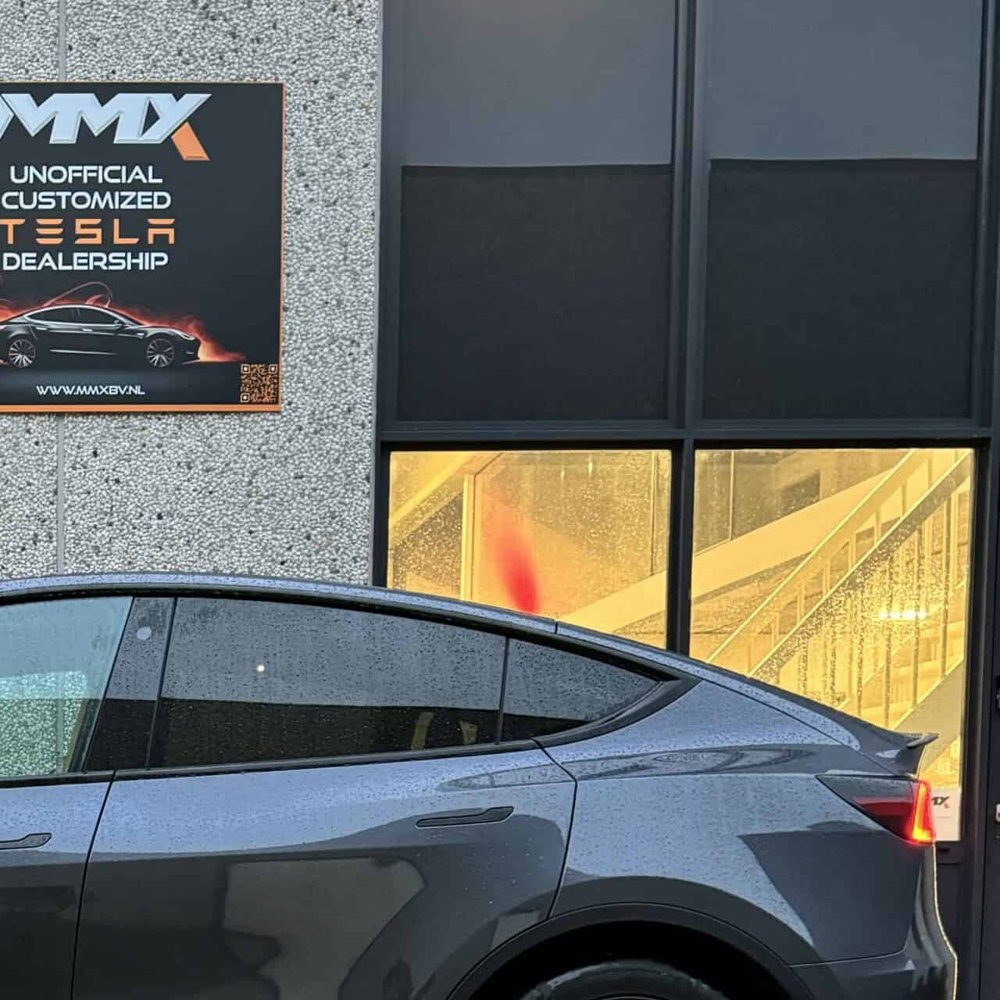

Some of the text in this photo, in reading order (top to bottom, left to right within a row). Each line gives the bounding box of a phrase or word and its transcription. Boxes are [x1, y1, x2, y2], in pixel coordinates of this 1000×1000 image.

[10, 165, 163, 184] UNOFFICIAL
[1, 191, 171, 210] CUSTOMIZED
[3, 252, 169, 271] DEALERSHIP
[36, 384, 145, 396] WWW.MMXBV.NL
